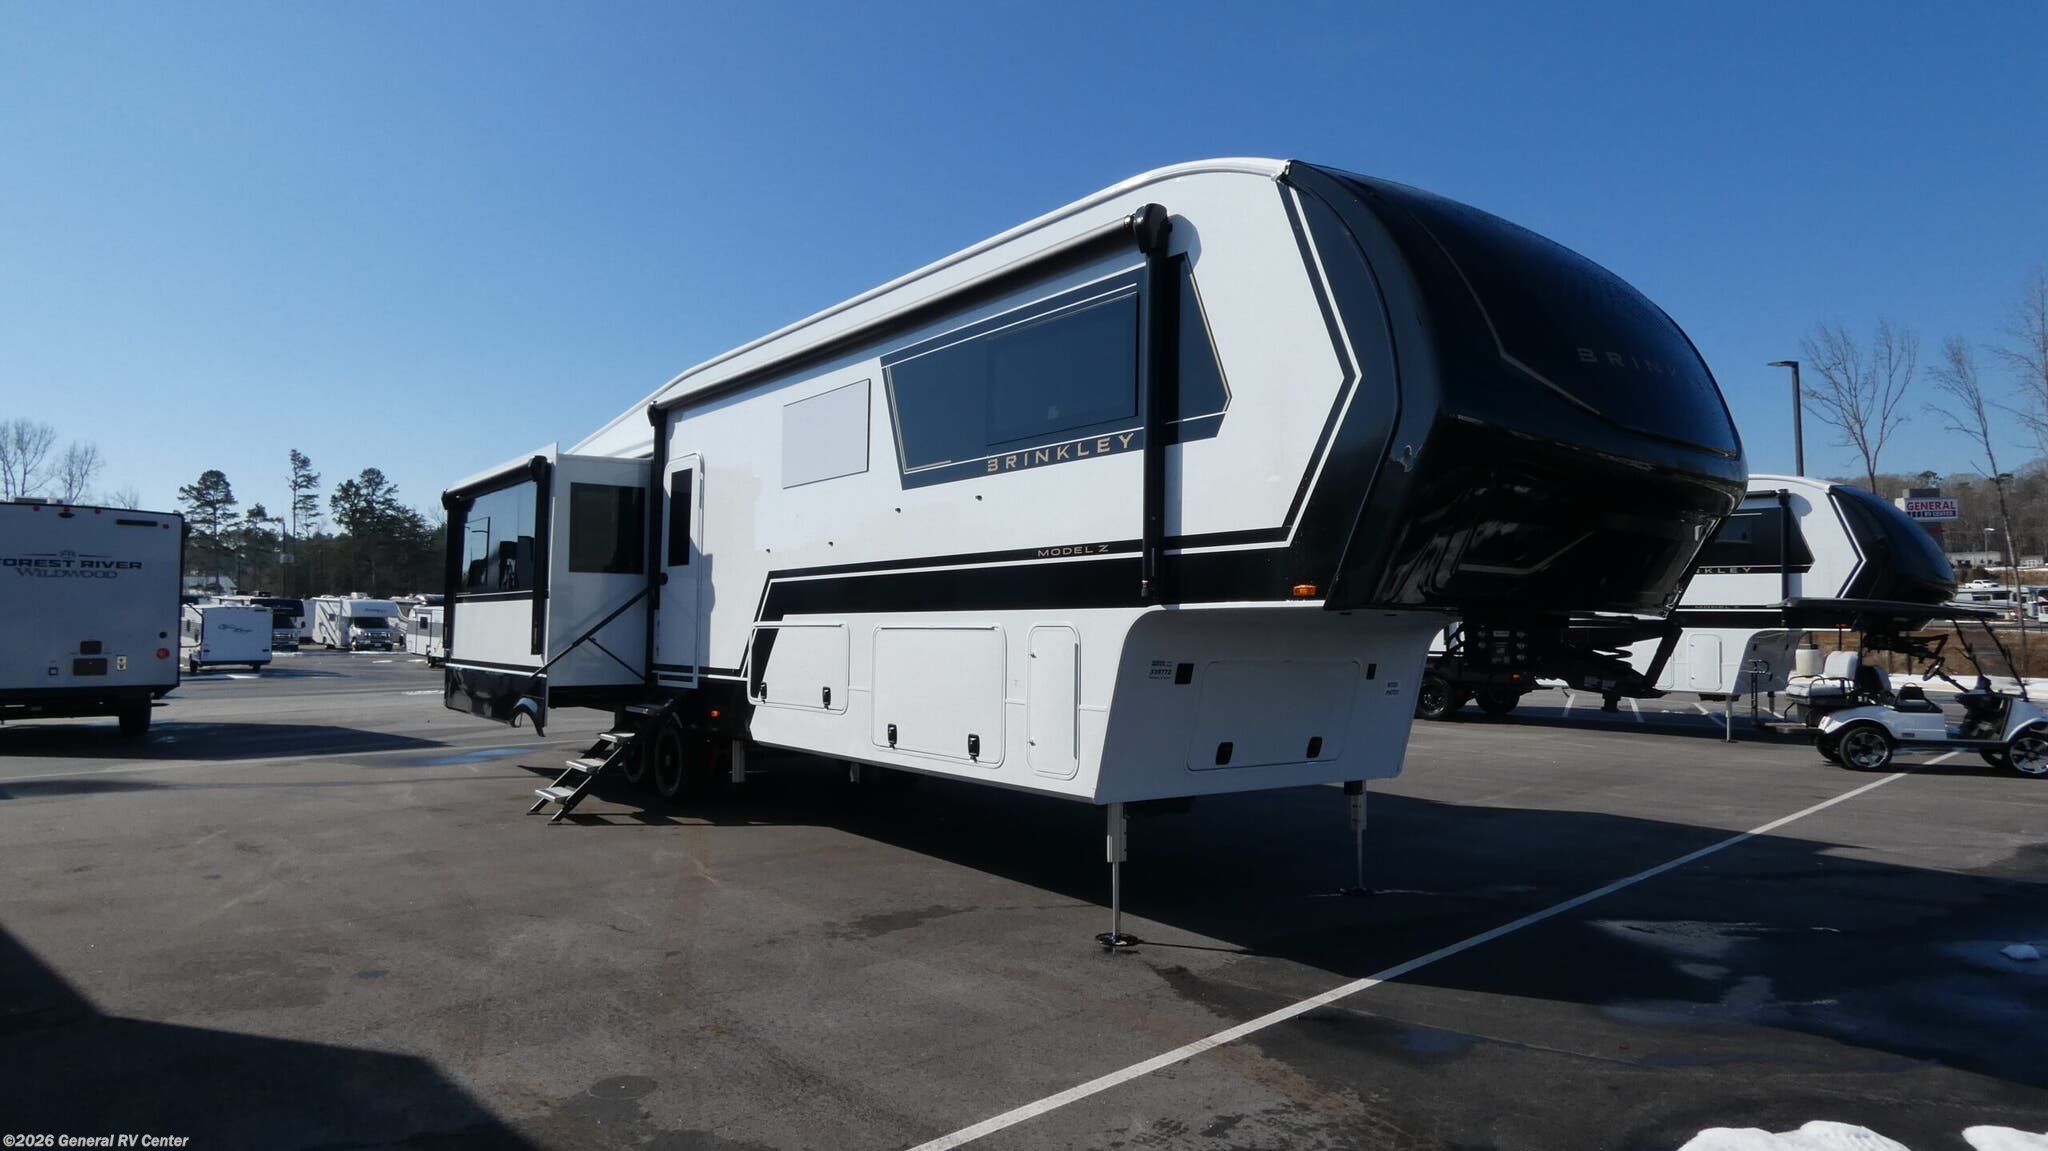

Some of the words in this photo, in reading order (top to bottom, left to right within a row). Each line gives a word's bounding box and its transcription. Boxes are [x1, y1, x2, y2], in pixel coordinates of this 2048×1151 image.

[987, 432, 1134, 472] BRINKLEY
[1906, 501, 1956, 511] GENERAL
[1037, 546, 1093, 557] MODEL
[1099, 544, 1109, 553] Z
[0, 558, 75, 568] OREST
[80, 560, 143, 569] RIVER
[16, 567, 118, 579] WILDWOOD
